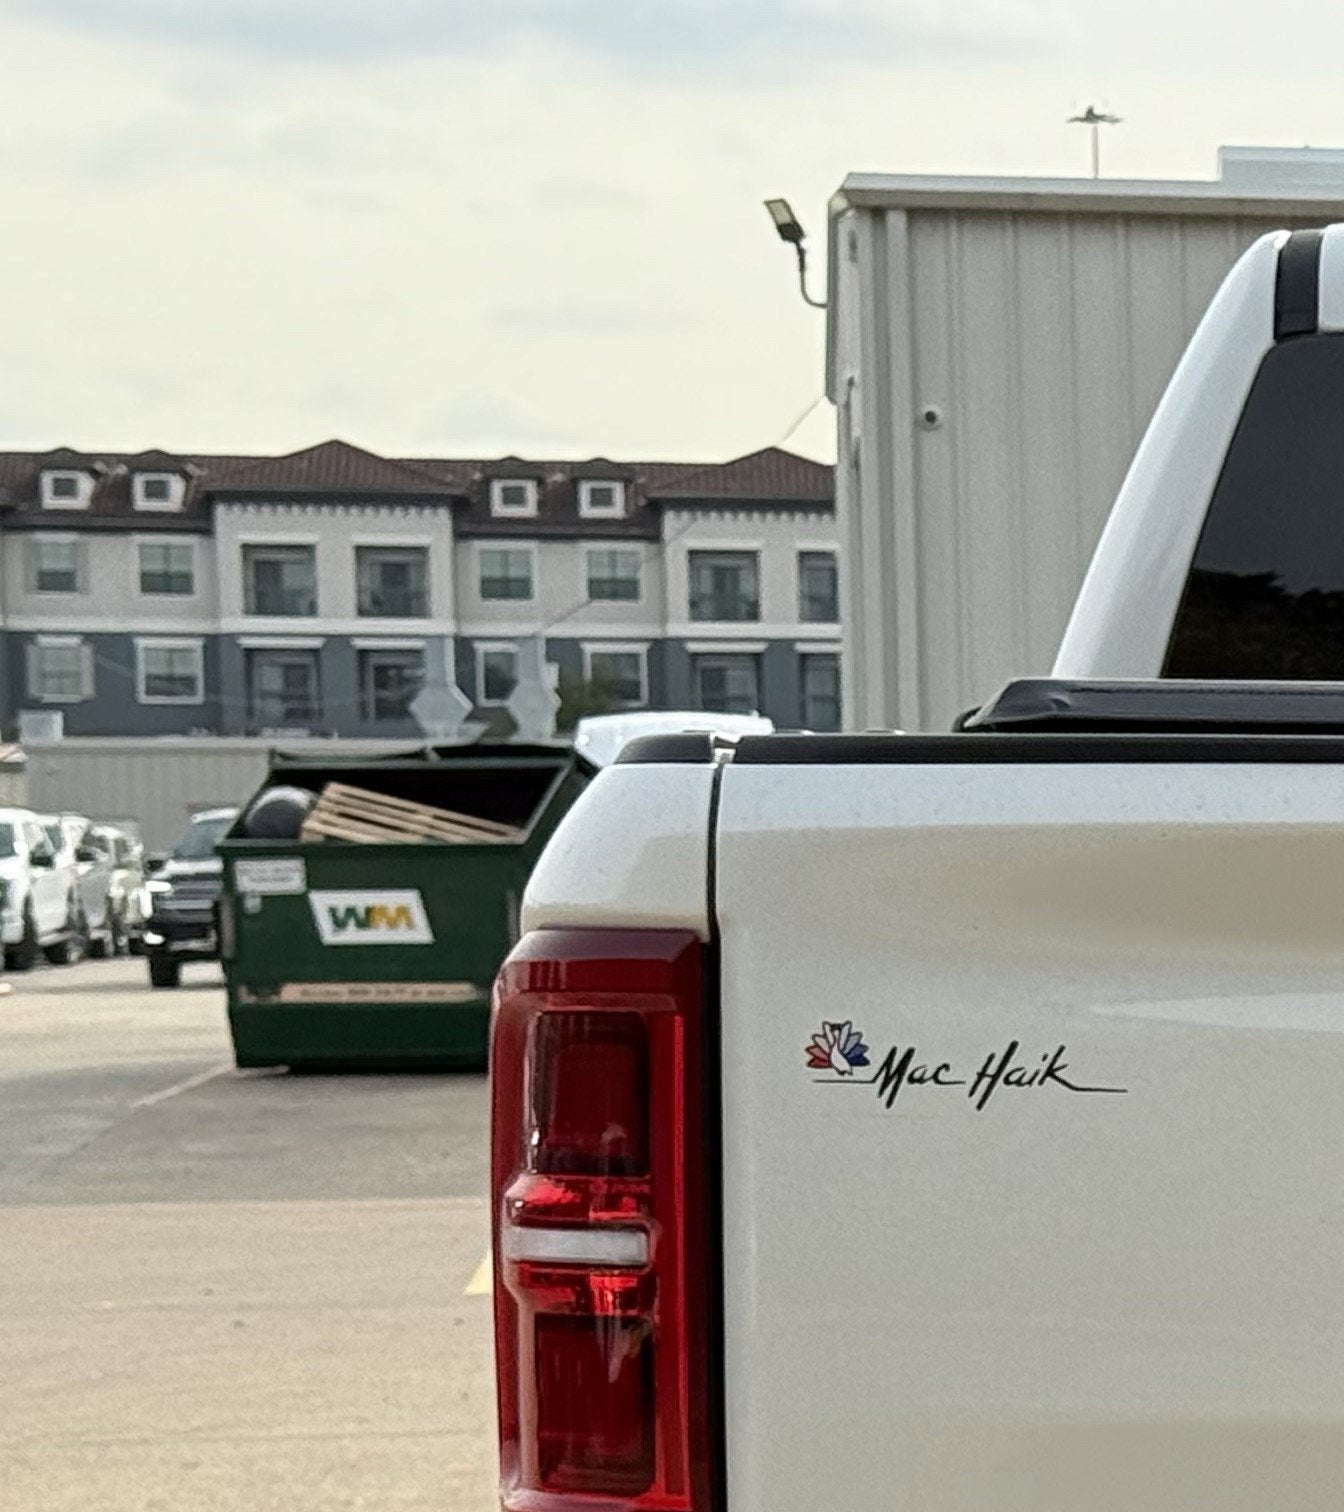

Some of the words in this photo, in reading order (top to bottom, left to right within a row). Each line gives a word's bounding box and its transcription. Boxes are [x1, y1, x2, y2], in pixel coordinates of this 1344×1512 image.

[328, 904, 415, 931] WM
[812, 1046, 967, 1110] Mac
[968, 1040, 1128, 1111] Haik
